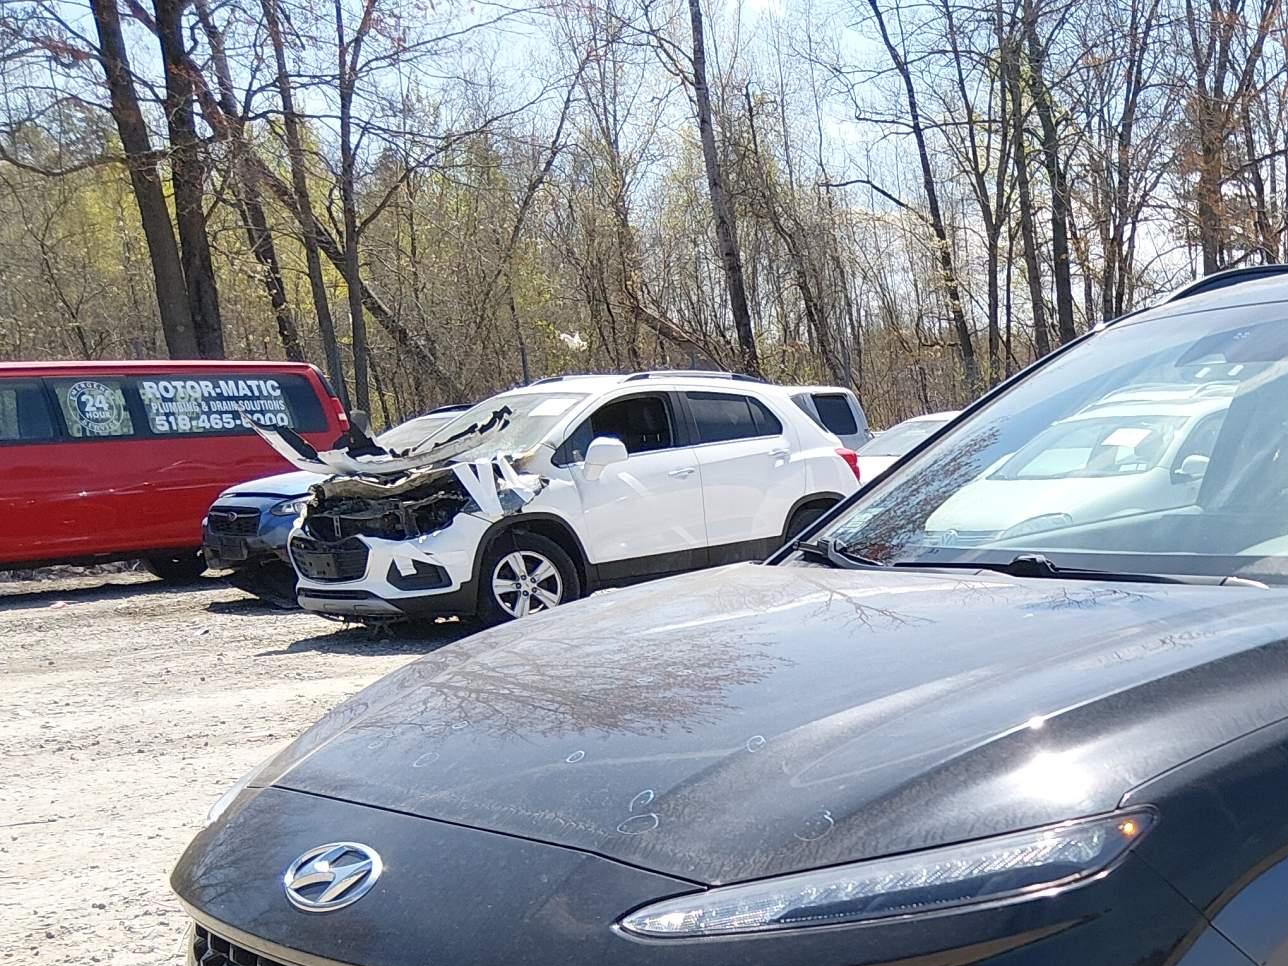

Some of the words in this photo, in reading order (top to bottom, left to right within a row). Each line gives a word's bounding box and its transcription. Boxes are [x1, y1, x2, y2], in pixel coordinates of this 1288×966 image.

[143, 380, 281, 398] ROTOR-MATIC
[81, 394, 109, 411] 24
[151, 401, 199, 413] PLUMBING
[201, 401, 208, 411] &
[210, 401, 238, 411] DRAIN
[239, 400, 285, 411] SOLUTIONS
